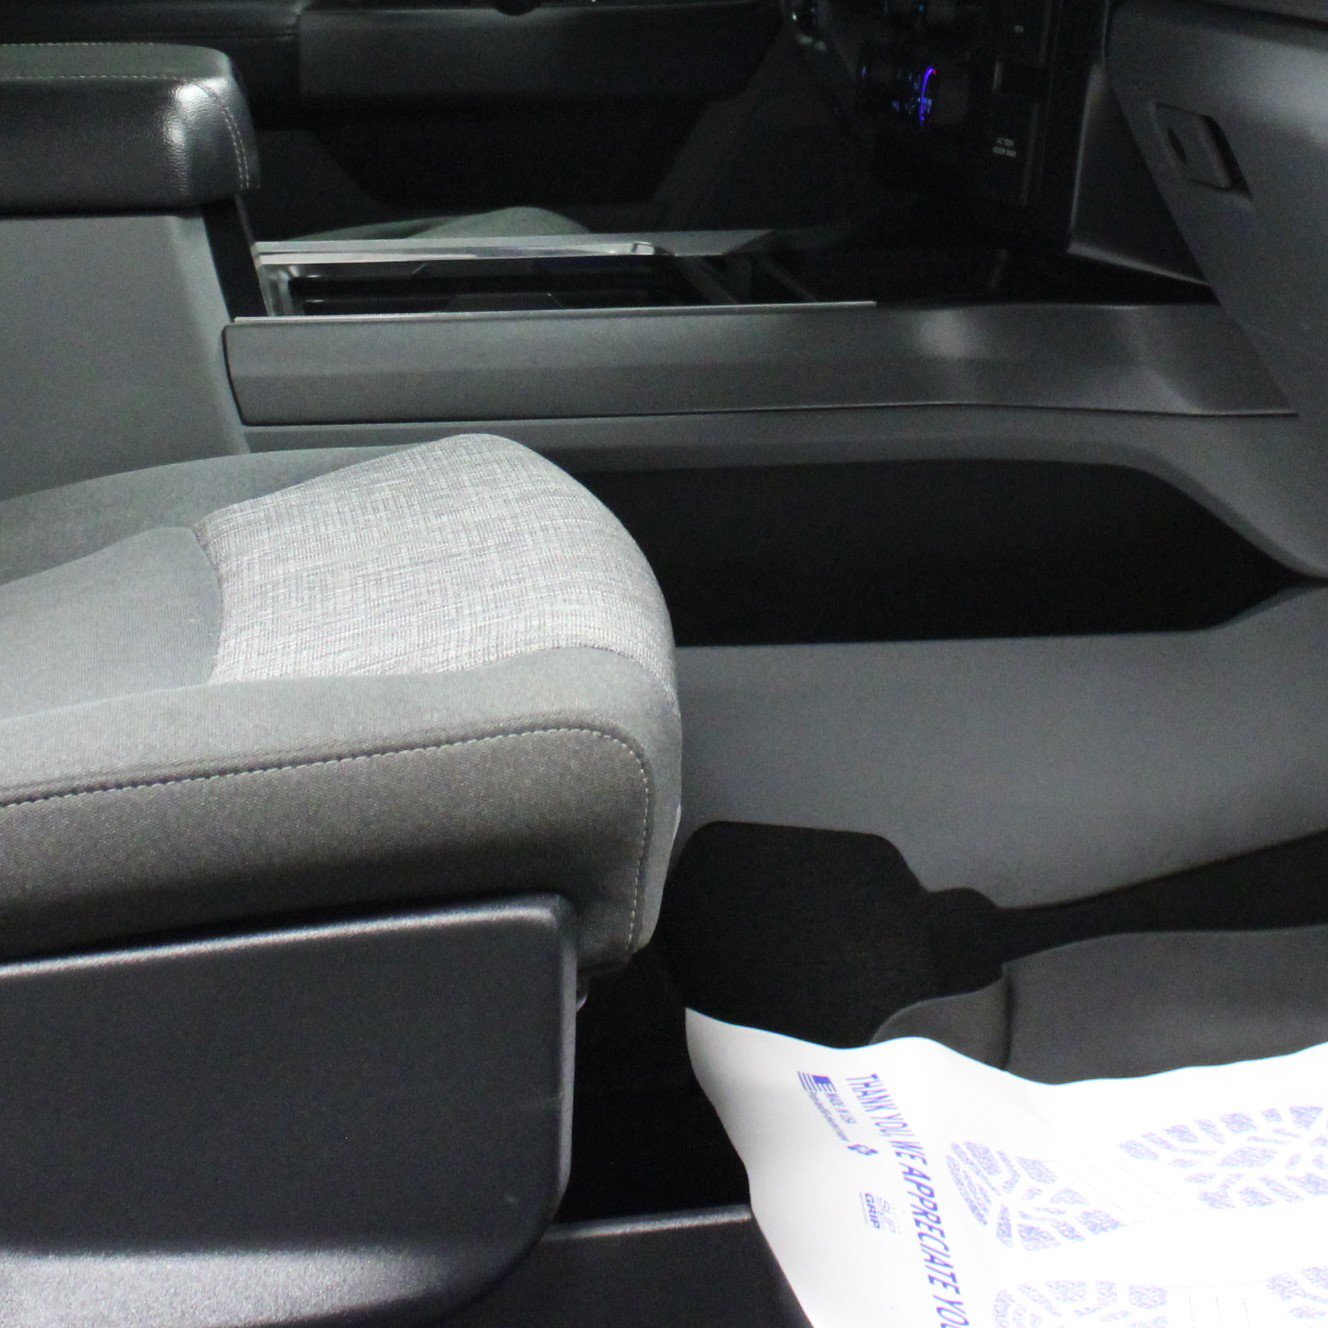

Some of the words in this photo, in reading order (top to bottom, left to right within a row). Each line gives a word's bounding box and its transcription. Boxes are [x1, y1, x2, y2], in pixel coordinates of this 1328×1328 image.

[845, 1073, 899, 1113] THANK
[888, 1139, 927, 1166] WE
[864, 1191, 881, 1230] GRIP
[899, 1161, 961, 1296] APPRECIATE
